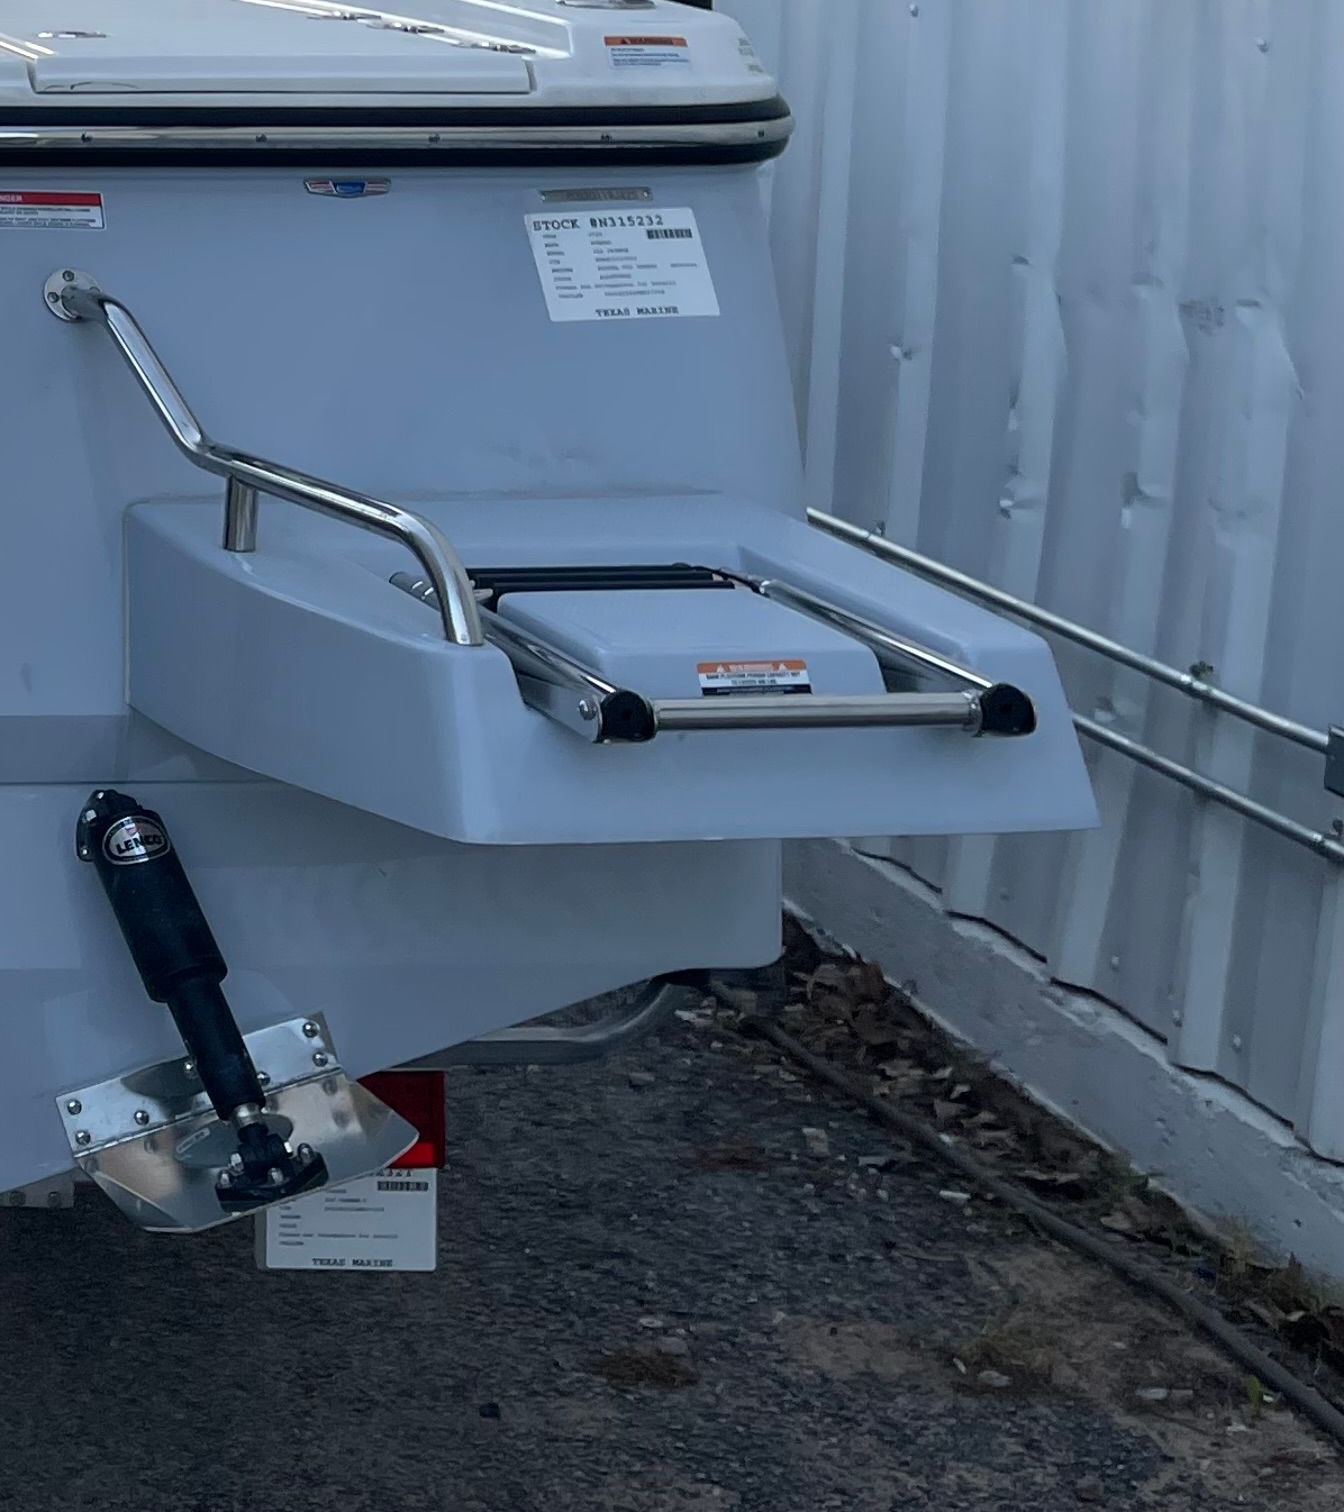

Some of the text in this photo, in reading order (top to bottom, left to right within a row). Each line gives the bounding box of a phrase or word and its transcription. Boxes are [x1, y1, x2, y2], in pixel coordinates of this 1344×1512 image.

[533, 218, 580, 231] STOCK
[595, 306, 679, 318] TEXAS MARINE
[352, 1258, 394, 1267] MARINE
